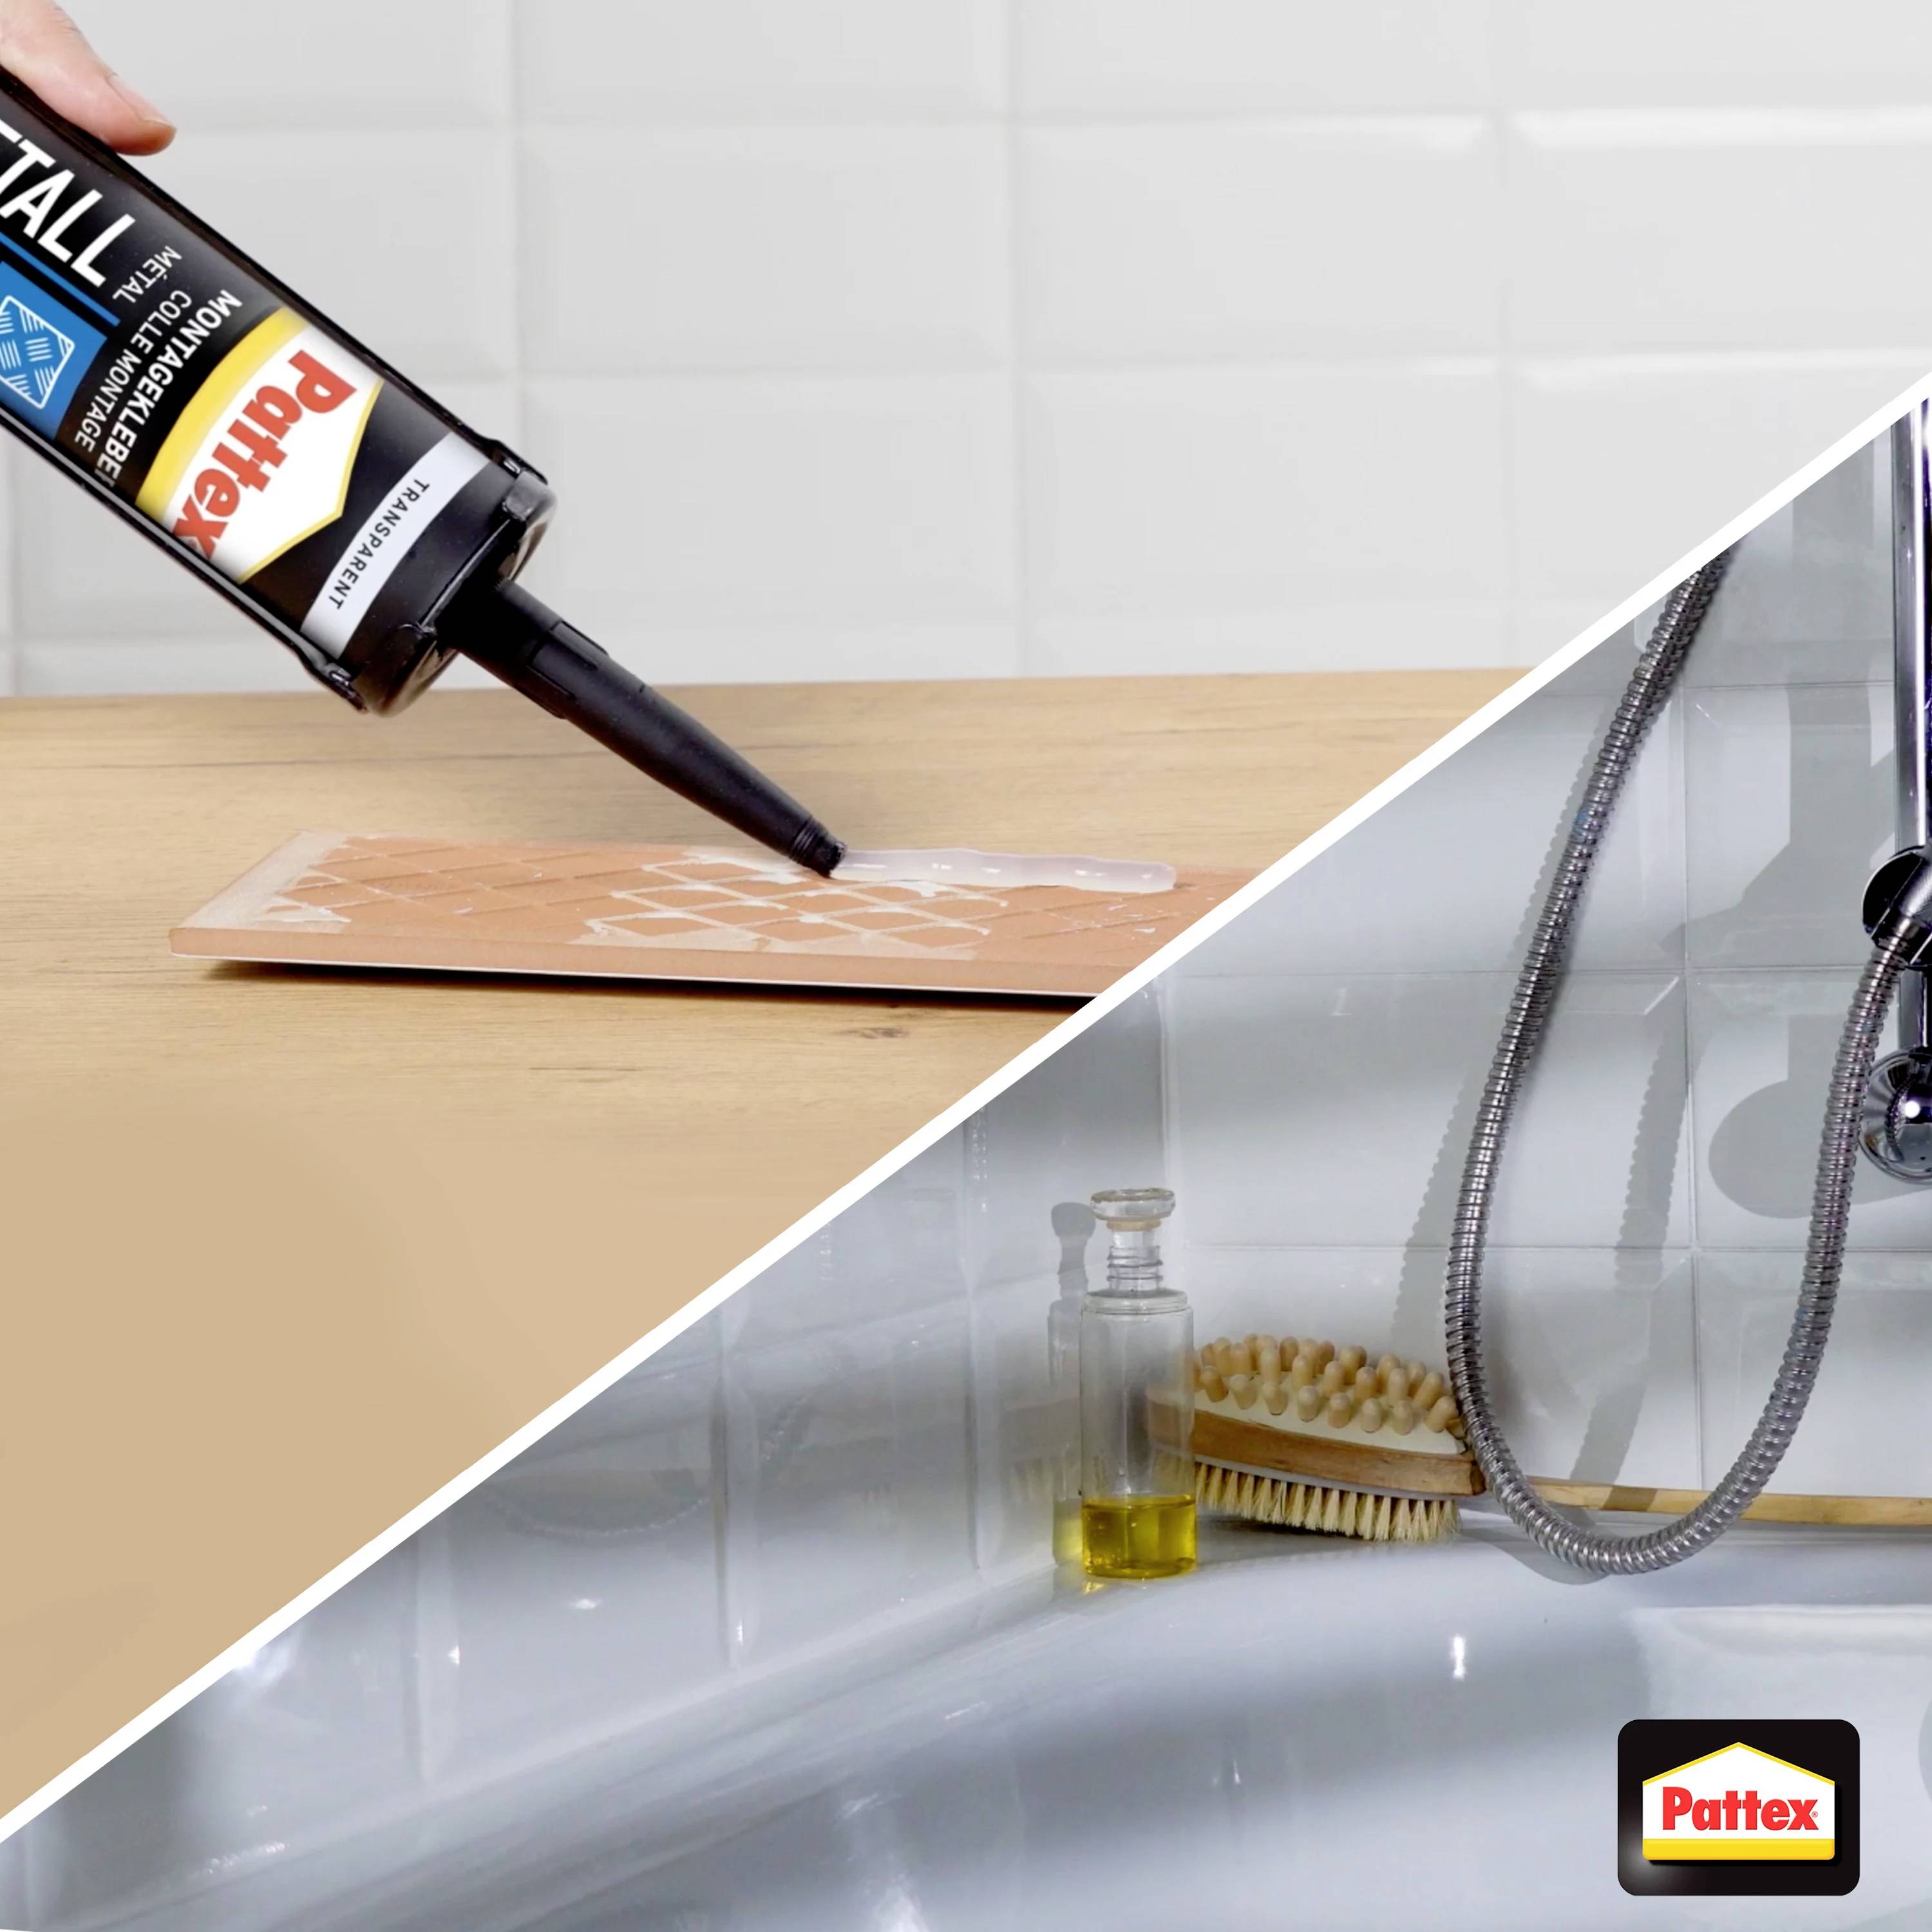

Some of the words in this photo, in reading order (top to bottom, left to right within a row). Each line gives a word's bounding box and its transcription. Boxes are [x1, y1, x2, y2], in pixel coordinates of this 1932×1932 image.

[113, 245, 182, 303] MÉTAL
[130, 290, 192, 354] COLLE
[75, 348, 142, 452] MONTAGE
[172, 350, 357, 560] Pattex
[328, 479, 430, 609] TRANSPARENT
